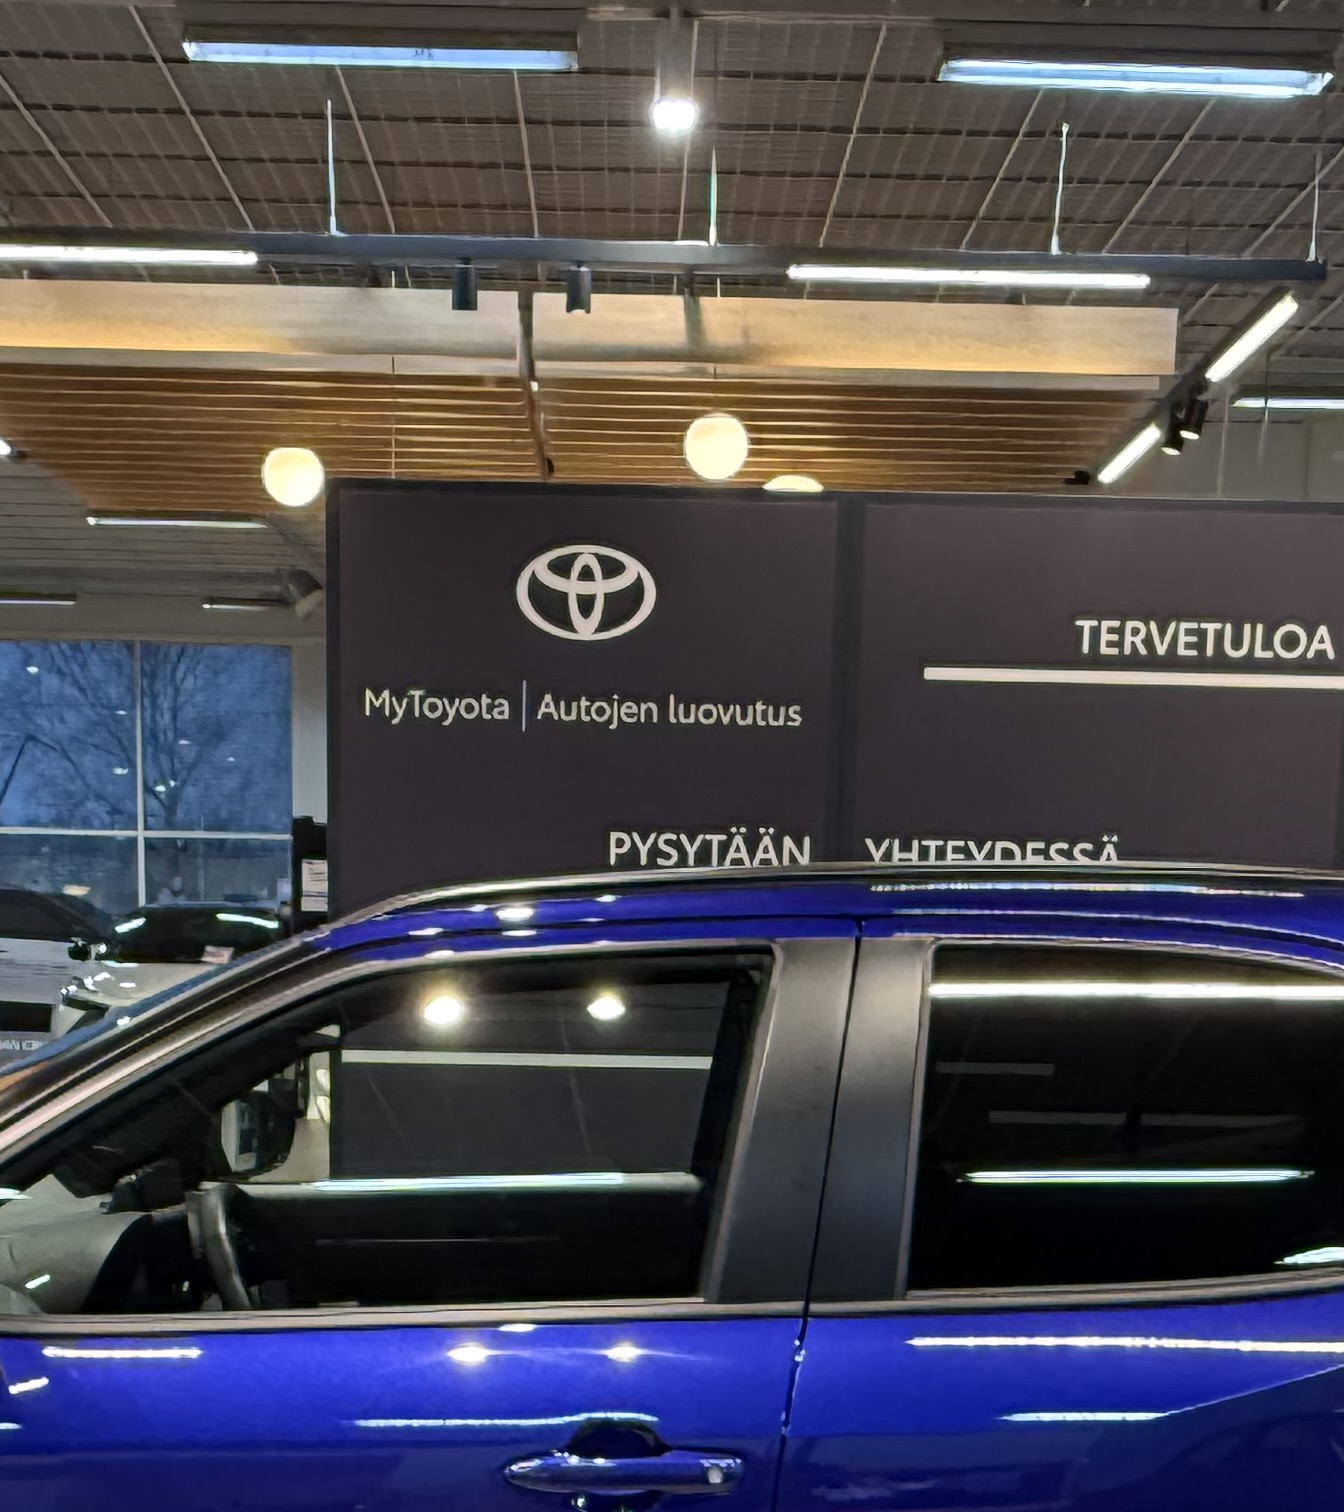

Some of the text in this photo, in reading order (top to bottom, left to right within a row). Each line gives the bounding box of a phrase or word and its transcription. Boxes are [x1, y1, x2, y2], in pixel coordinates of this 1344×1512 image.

[1074, 618, 1336, 661] TERVETULOA
[364, 688, 803, 730] MyToyota Autojen luovutus
[609, 826, 811, 867] PYSYTÄÄN
